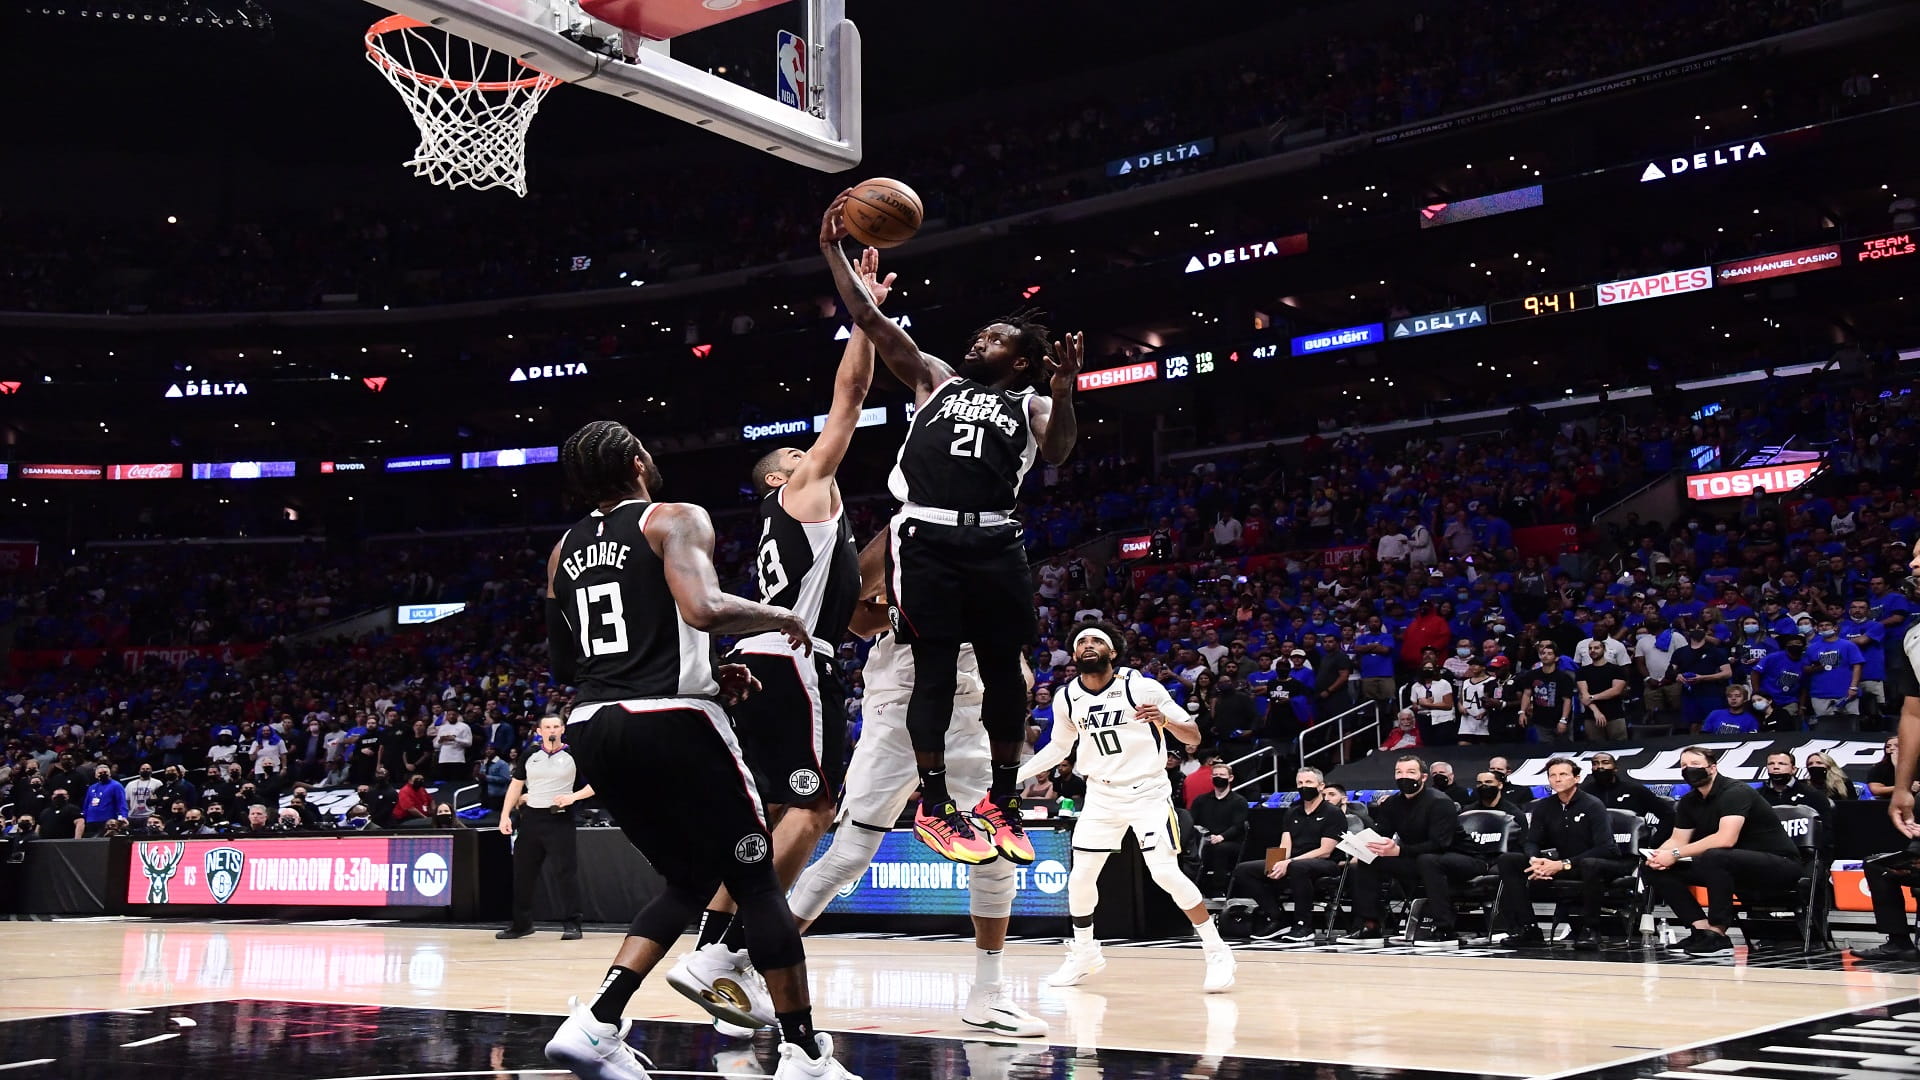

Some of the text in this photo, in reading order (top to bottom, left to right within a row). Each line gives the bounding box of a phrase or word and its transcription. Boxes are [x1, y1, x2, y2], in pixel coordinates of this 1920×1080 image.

[781, 88, 796, 106] NBA
[1138, 144, 1201, 169] DELTA
[1671, 141, 1767, 174] DELTA
[1207, 241, 1279, 267] DELTA
[1858, 243, 1916, 262] FOULS
[1863, 234, 1910, 251] TEAM
[1730, 251, 1838, 277] SAN MANUEL CASINO
[1600, 269, 1708, 303] STAPLES
[1524, 291, 1575, 316] 9:41
[1414, 310, 1483, 333] DELTA
[1304, 330, 1370, 351] BUD LIGHT
[1165, 355, 1189, 369] UTA
[1252, 345, 1277, 359] 41.7
[529, 362, 588, 379] DELTA
[1078, 364, 1157, 389] TOSHIBA
[1166, 365, 1189, 379] LAC
[186, 382, 248, 397] DELTA
[955, 388, 1000, 408] Los
[925, 394, 1020, 437] Angeles
[743, 420, 807, 441] Spectrum
[949, 423, 985, 459] 21
[335, 463, 366, 471] TOYOTA
[1690, 467, 1819, 497] TOSHIB
[562, 541, 632, 581] GEORGE
[575, 581, 629, 658] 13
[1078, 704, 1128, 731] JAZZ
[1090, 729, 1123, 757] 10
[206, 850, 241, 873] NETS
[183, 865, 198, 886] VS
[249, 857, 332, 891] TOMORROW
[391, 863, 408, 892] ET
[869, 862, 953, 889] TOMORROW
